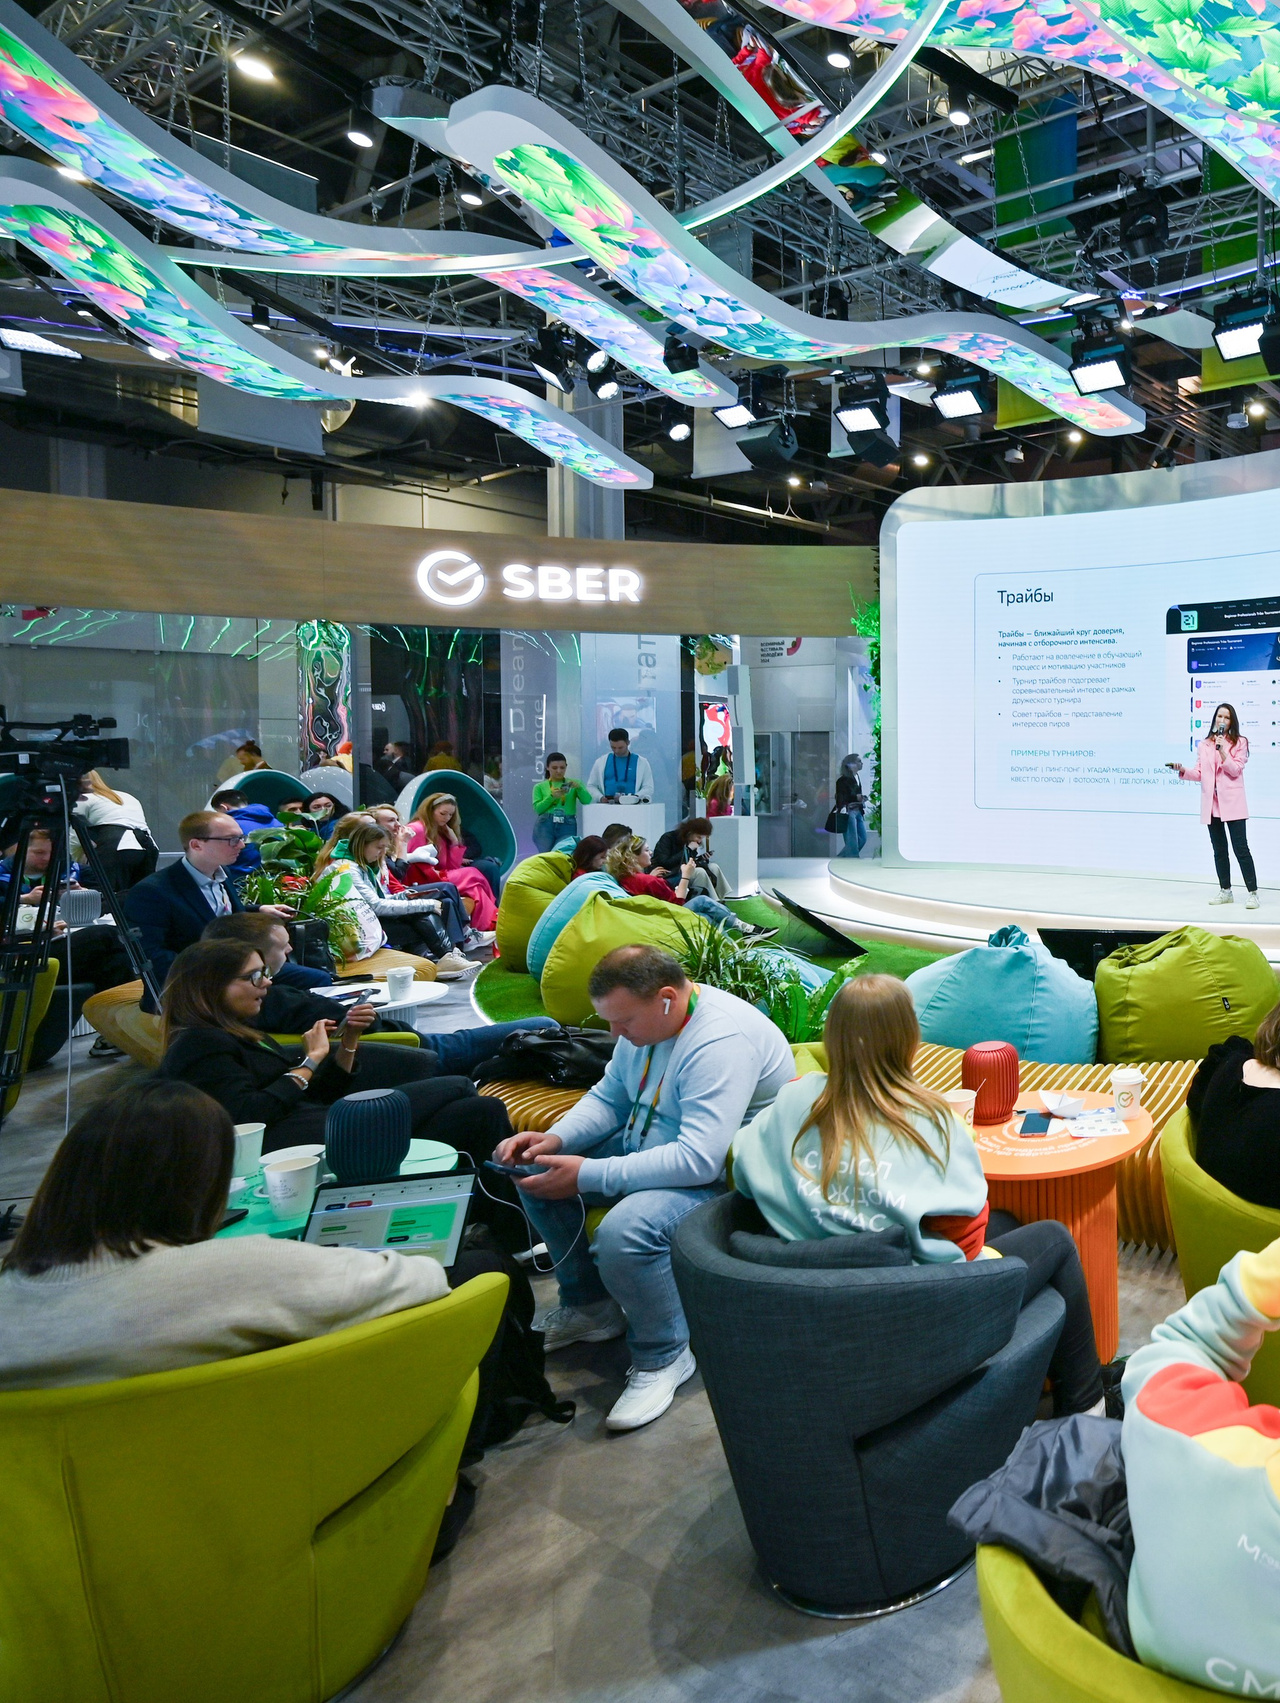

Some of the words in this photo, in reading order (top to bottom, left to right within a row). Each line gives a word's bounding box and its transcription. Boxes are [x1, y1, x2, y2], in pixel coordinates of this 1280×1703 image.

[502, 563, 642, 602] SBER
[997, 588, 1054, 607] Трайбы
[998, 630, 1024, 638] Трайбы
[1034, 629, 1075, 637] ближайший
[1093, 628, 1125, 636] доверия,
[1033, 639, 1078, 647] отборочного
[1012, 653, 1044, 661] Работают
[1103, 650, 1142, 660] обучающий
[1048, 663, 1086, 671] мотивацию
[1087, 662, 1126, 670] участников
[1038, 677, 1066, 685] трайбов
[1067, 677, 1110, 685] подогревает
[1012, 687, 1076, 695] соревновательный
[1111, 686, 1136, 694] рамках
[1012, 697, 1052, 705] дружеского
[1053, 697, 1082, 705] турнира
[1034, 710, 1062, 719] трайбов
